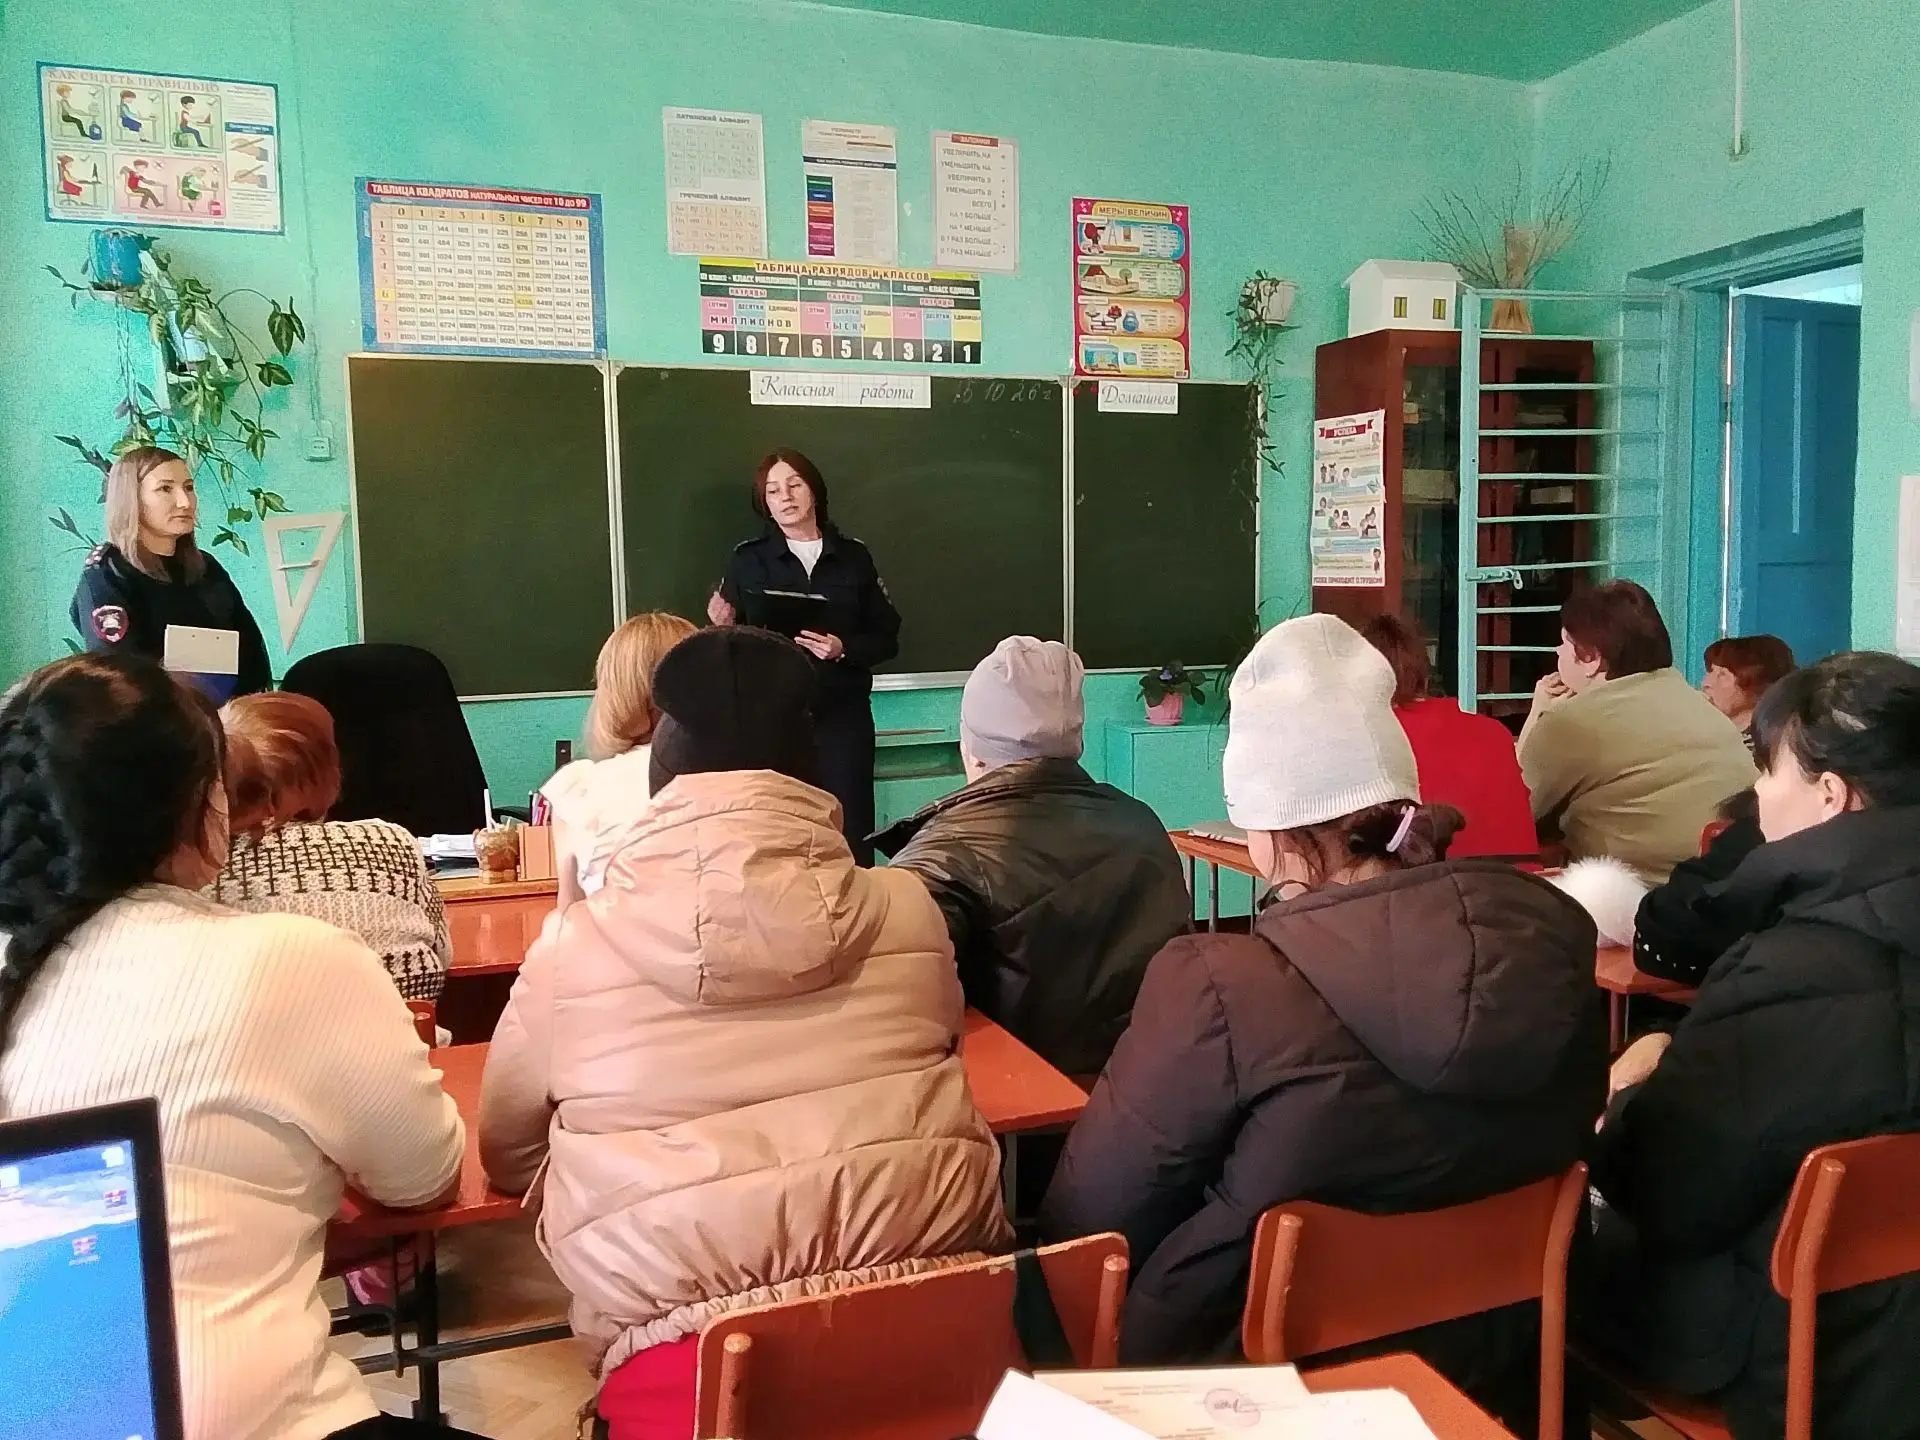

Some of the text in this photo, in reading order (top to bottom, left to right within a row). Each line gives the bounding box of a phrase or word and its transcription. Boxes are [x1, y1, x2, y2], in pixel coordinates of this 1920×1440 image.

[370, 184, 416, 196] ТАБЛИЦА
[416, 187, 470, 199] КВАДРАТОВ
[554, 198, 564, 206] 10
[576, 199, 587, 208] 99
[398, 208, 406, 216] 0
[498, 214, 506, 222] 5
[518, 215, 525, 224] 6
[537, 217, 544, 225] 7
[1100, 207, 1168, 219] МЕРЫ ВЕЛИЧИН
[756, 262, 808, 274] ТАБЛИЦА
[812, 266, 868, 279] РАЗРЯДОВ
[884, 270, 930, 281] КЛАССОВ
[710, 316, 792, 328] МИЛЛИОНОВ
[824, 320, 866, 331] ТЫСЯЧ
[712, 333, 972, 362] 9 8 7 6 5 4 3 2 1
[760, 375, 914, 405] Классная работа
[1101, 384, 1176, 406] Домашняя
